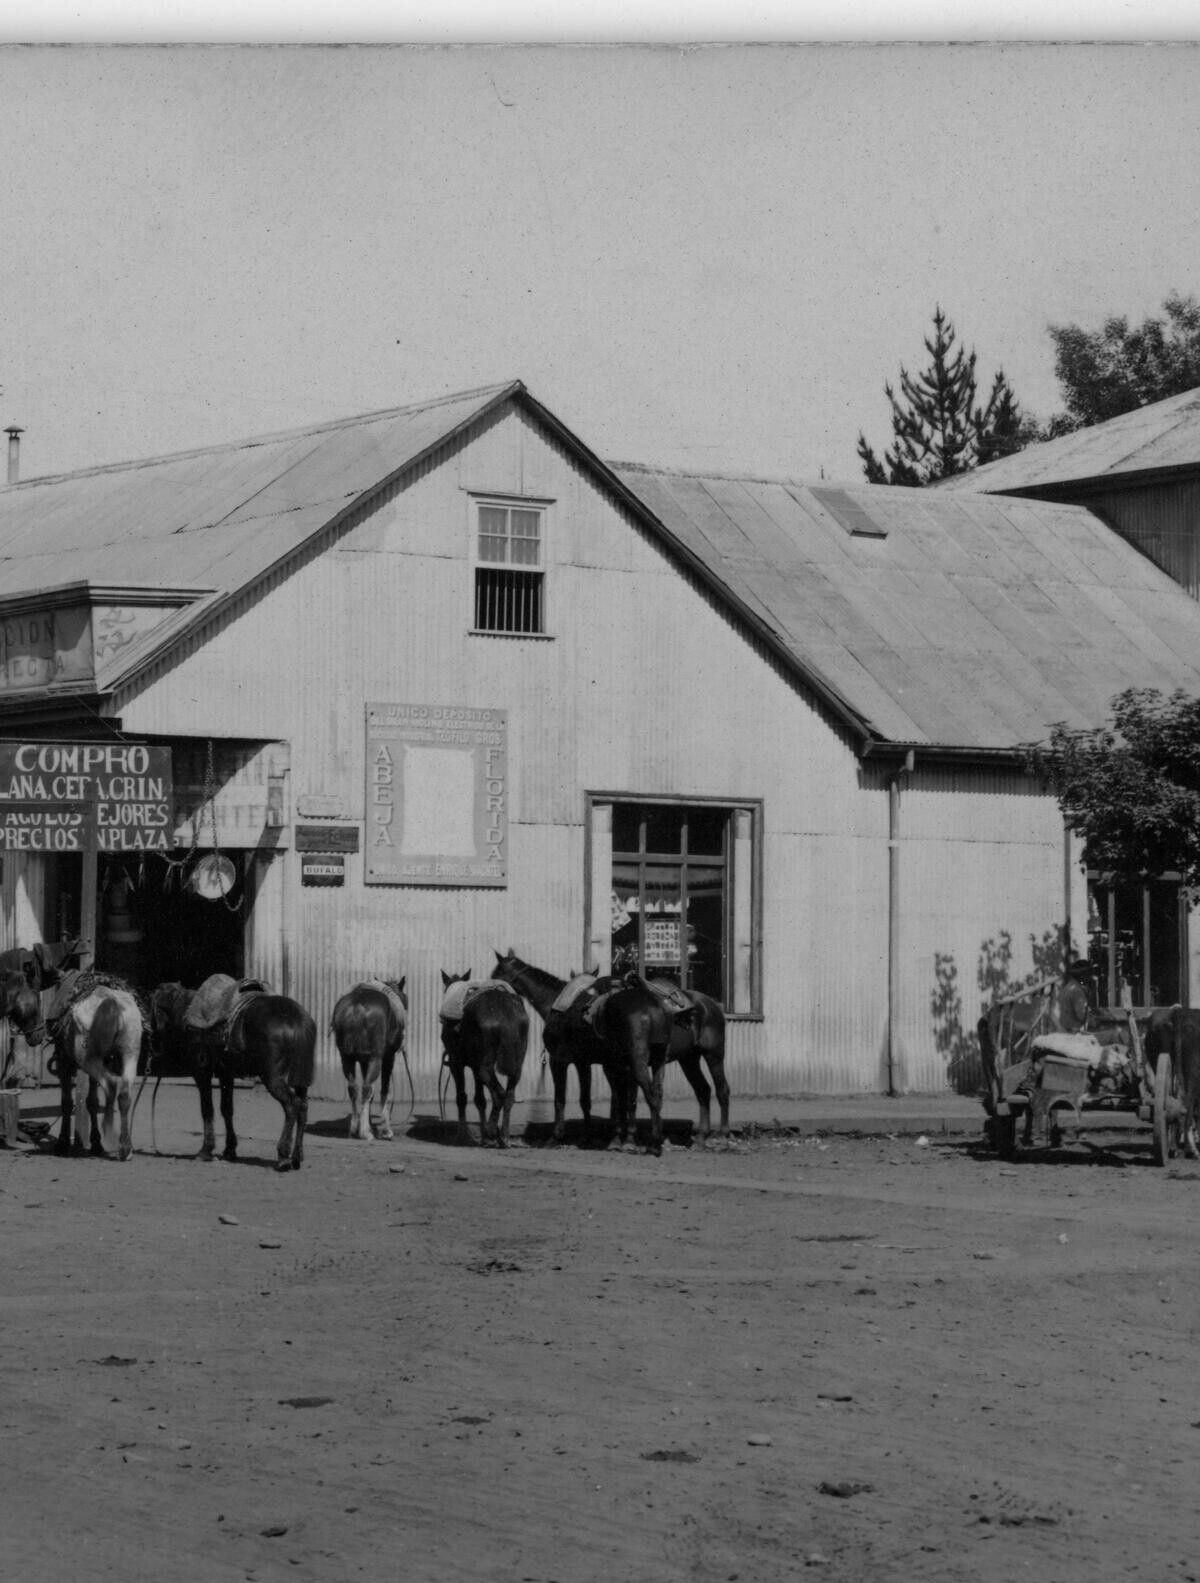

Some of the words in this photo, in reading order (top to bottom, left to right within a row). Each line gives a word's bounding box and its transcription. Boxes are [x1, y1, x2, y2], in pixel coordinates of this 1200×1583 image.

[386, 705, 429, 719] UNICO
[433, 708, 493, 722] DEPOSITO
[14, 745, 150, 775] COMPRO
[108, 776, 167, 803] CRIN,
[373, 745, 396, 847] ABEJA
[97, 803, 169, 828] EJORES
[485, 748, 505, 863] FLORIDA
